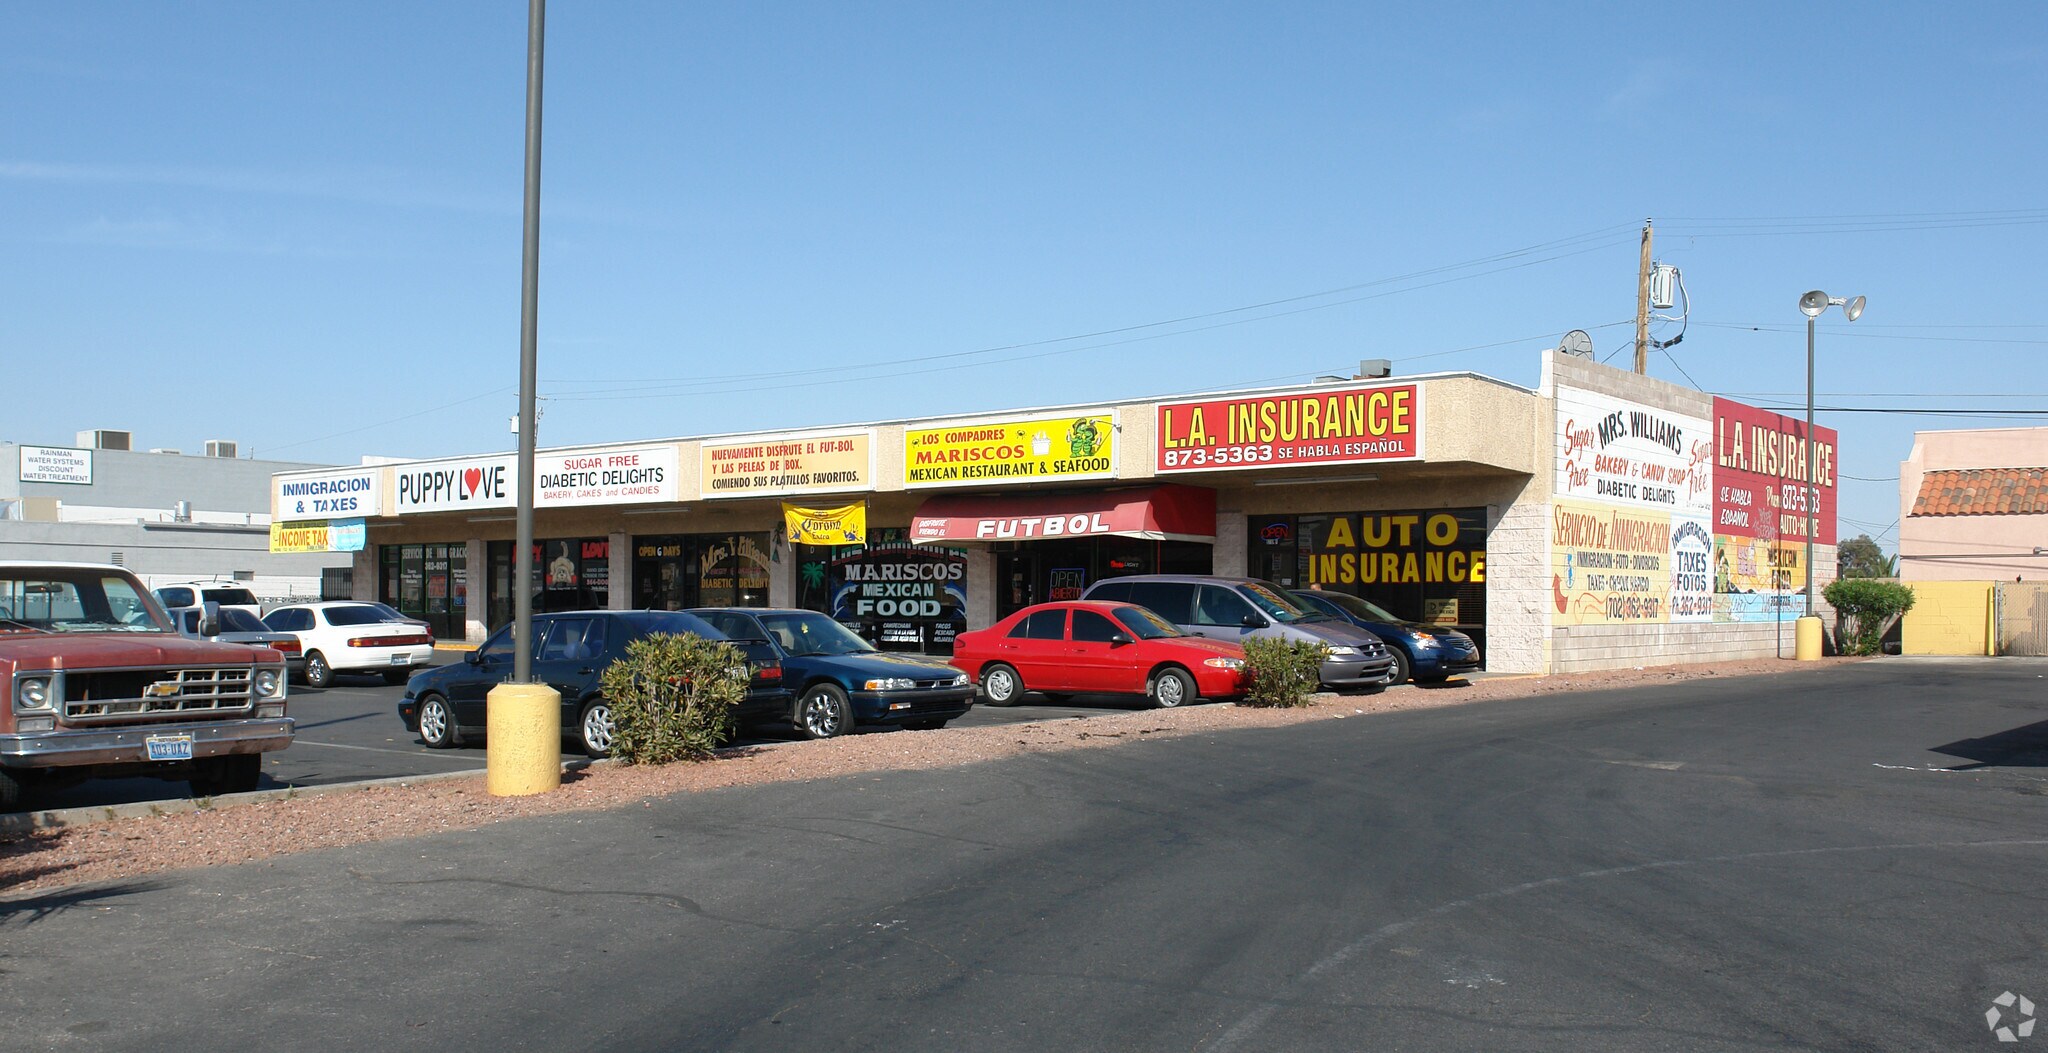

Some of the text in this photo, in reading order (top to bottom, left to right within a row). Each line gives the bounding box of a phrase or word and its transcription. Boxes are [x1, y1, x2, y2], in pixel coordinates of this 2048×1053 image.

[1164, 390, 1410, 449] L.A. INSURANCE
[922, 428, 1005, 445] LOS COMPADRES
[1564, 419, 1595, 461] Sugar
[1597, 410, 1682, 455] MRS. WILLIAMS
[40, 449, 72, 457] RAINMAN
[712, 440, 854, 461] NUEVAMENTE DISFRUTE EL FUT-BOL
[1164, 438, 1406, 467] 873-5363 SE HABLA ESPAÑOL
[1720, 416, 1748, 471] L.A.
[53, 457, 84, 466] SYSTEMS
[564, 455, 640, 470] SUGAR FREE
[915, 445, 1025, 465] MARISCOS
[1689, 439, 1713, 473] Sugar
[38, 465, 74, 473] DISCOUNT
[712, 459, 802, 474] Y LAS PELEAS DE BOX.
[909, 457, 1110, 481] MEXICAN RESTAURANT & SEAFOOD
[1566, 459, 1589, 492] Free
[1595, 454, 1685, 486] BAKERY & CANDY SHOP
[48, 473, 88, 482] TREATMENT
[283, 477, 370, 496] INMIGRACION
[540, 467, 664, 489] DIABETIC DELIGHTS
[712, 470, 860, 489] COMIENDO SUS PLATILLOS FAVORITOS.
[1687, 468, 1708, 500] Free
[400, 470, 454, 505] PUPPY
[543, 485, 660, 500] BAKERY, CAKES and CANDIES
[1597, 479, 1675, 505] DIABETIC DELIGHTS
[1720, 486, 1730, 502] SE
[1731, 488, 1752, 507] HABLA
[296, 497, 358, 513] & TAXES
[801, 518, 841, 533] Corona
[919, 519, 948, 528] DISFRUTE
[976, 513, 1110, 539] FUTBOL
[1720, 508, 1749, 528] ESPAÑOL
[279, 530, 310, 547] INCOME
[312, 529, 328, 546] TAX
[919, 528, 945, 536] VIENDO EL
[1260, 526, 1289, 539] OPEN
[1325, 513, 1459, 548] AUTO
[1553, 504, 1671, 554] SERVICIO DE INMIGRACION
[1671, 521, 1712, 553] INMIGRACION
[639, 546, 656, 557] OPEN
[662, 545, 681, 557] DAYS
[1577, 551, 1612, 569] INMIGRACION
[1616, 554, 1628, 569] FOTO
[701, 544, 728, 579] Mrs.
[1309, 551, 1486, 584] INSURANCE
[1677, 551, 1707, 573] TAXES
[844, 563, 963, 581] MARISCOS
[1051, 571, 1083, 588] OPEN
[701, 578, 733, 588] DIABETIC
[863, 583, 934, 597] MEXICAN
[1587, 574, 1605, 591] TAXES
[1677, 573, 1707, 592] FOTOS
[1050, 587, 1083, 600] ABIERTO
[857, 600, 941, 616] FOOD
